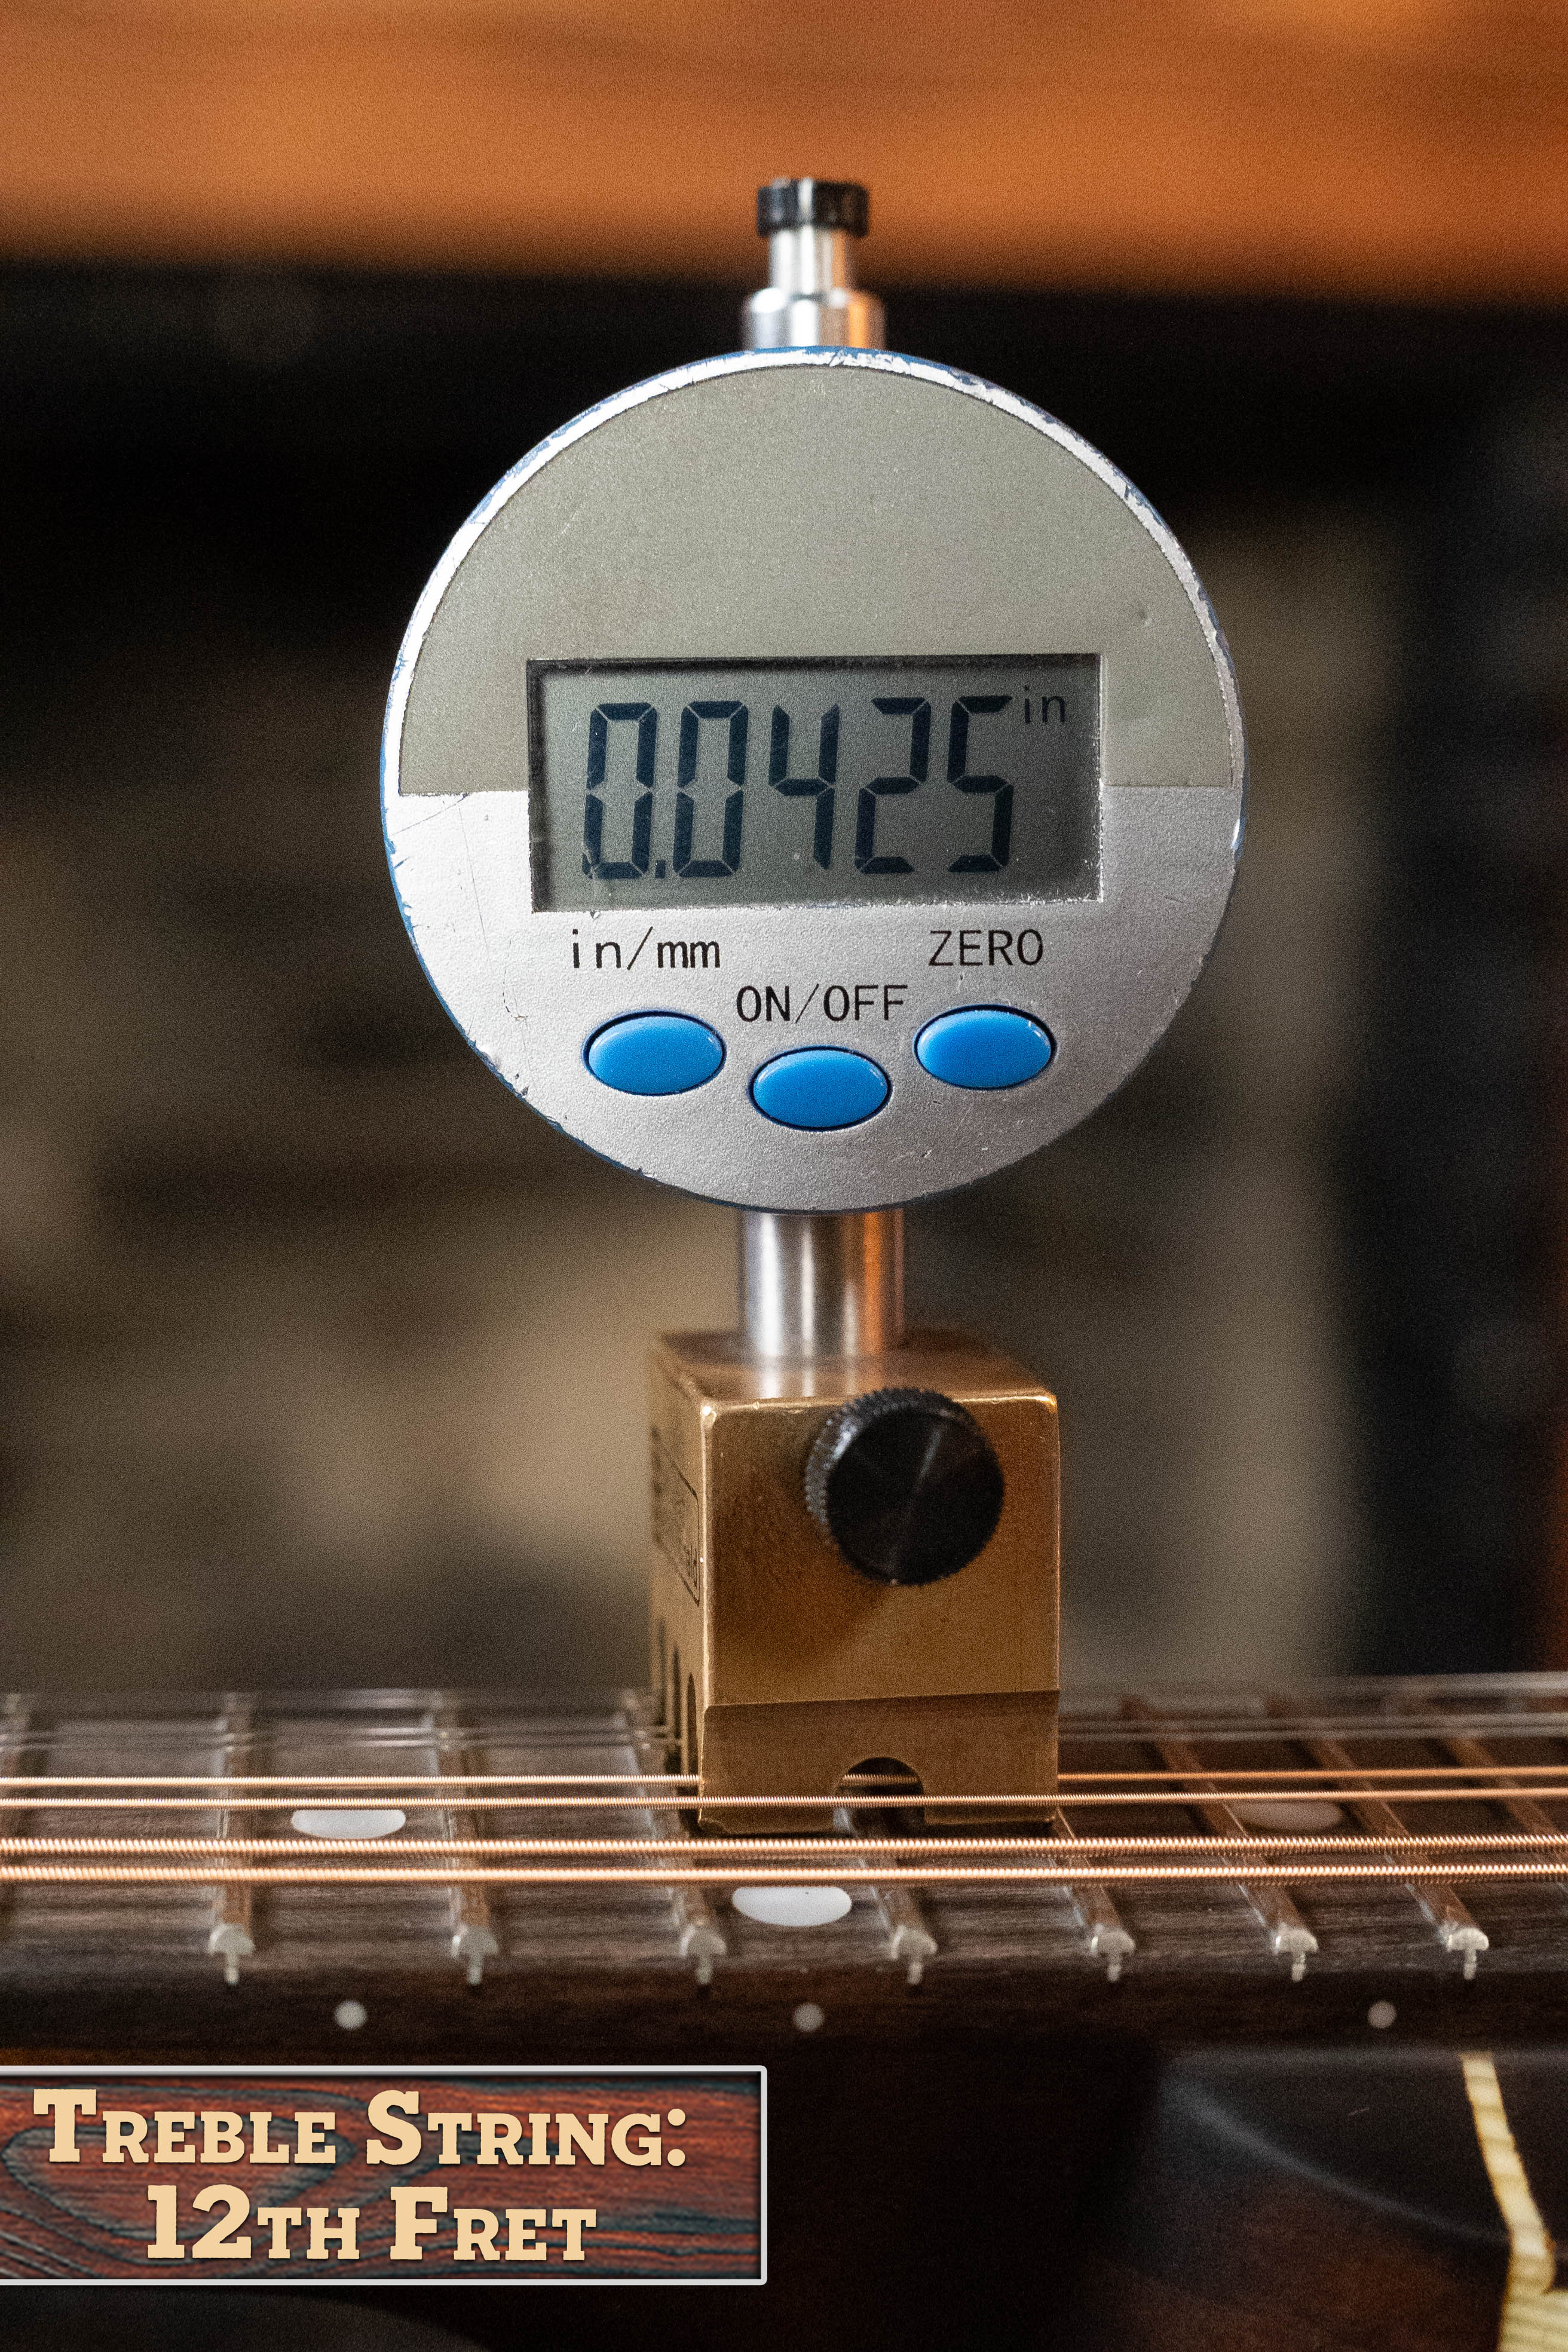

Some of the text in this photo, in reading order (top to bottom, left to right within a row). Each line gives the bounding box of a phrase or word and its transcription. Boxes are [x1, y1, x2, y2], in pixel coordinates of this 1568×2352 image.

[583, 685, 1067, 880] 0.0425 in
[572, 926, 721, 970] in/mm
[929, 929, 1044, 966] ZERO
[736, 984, 908, 1024] ON/OFF
